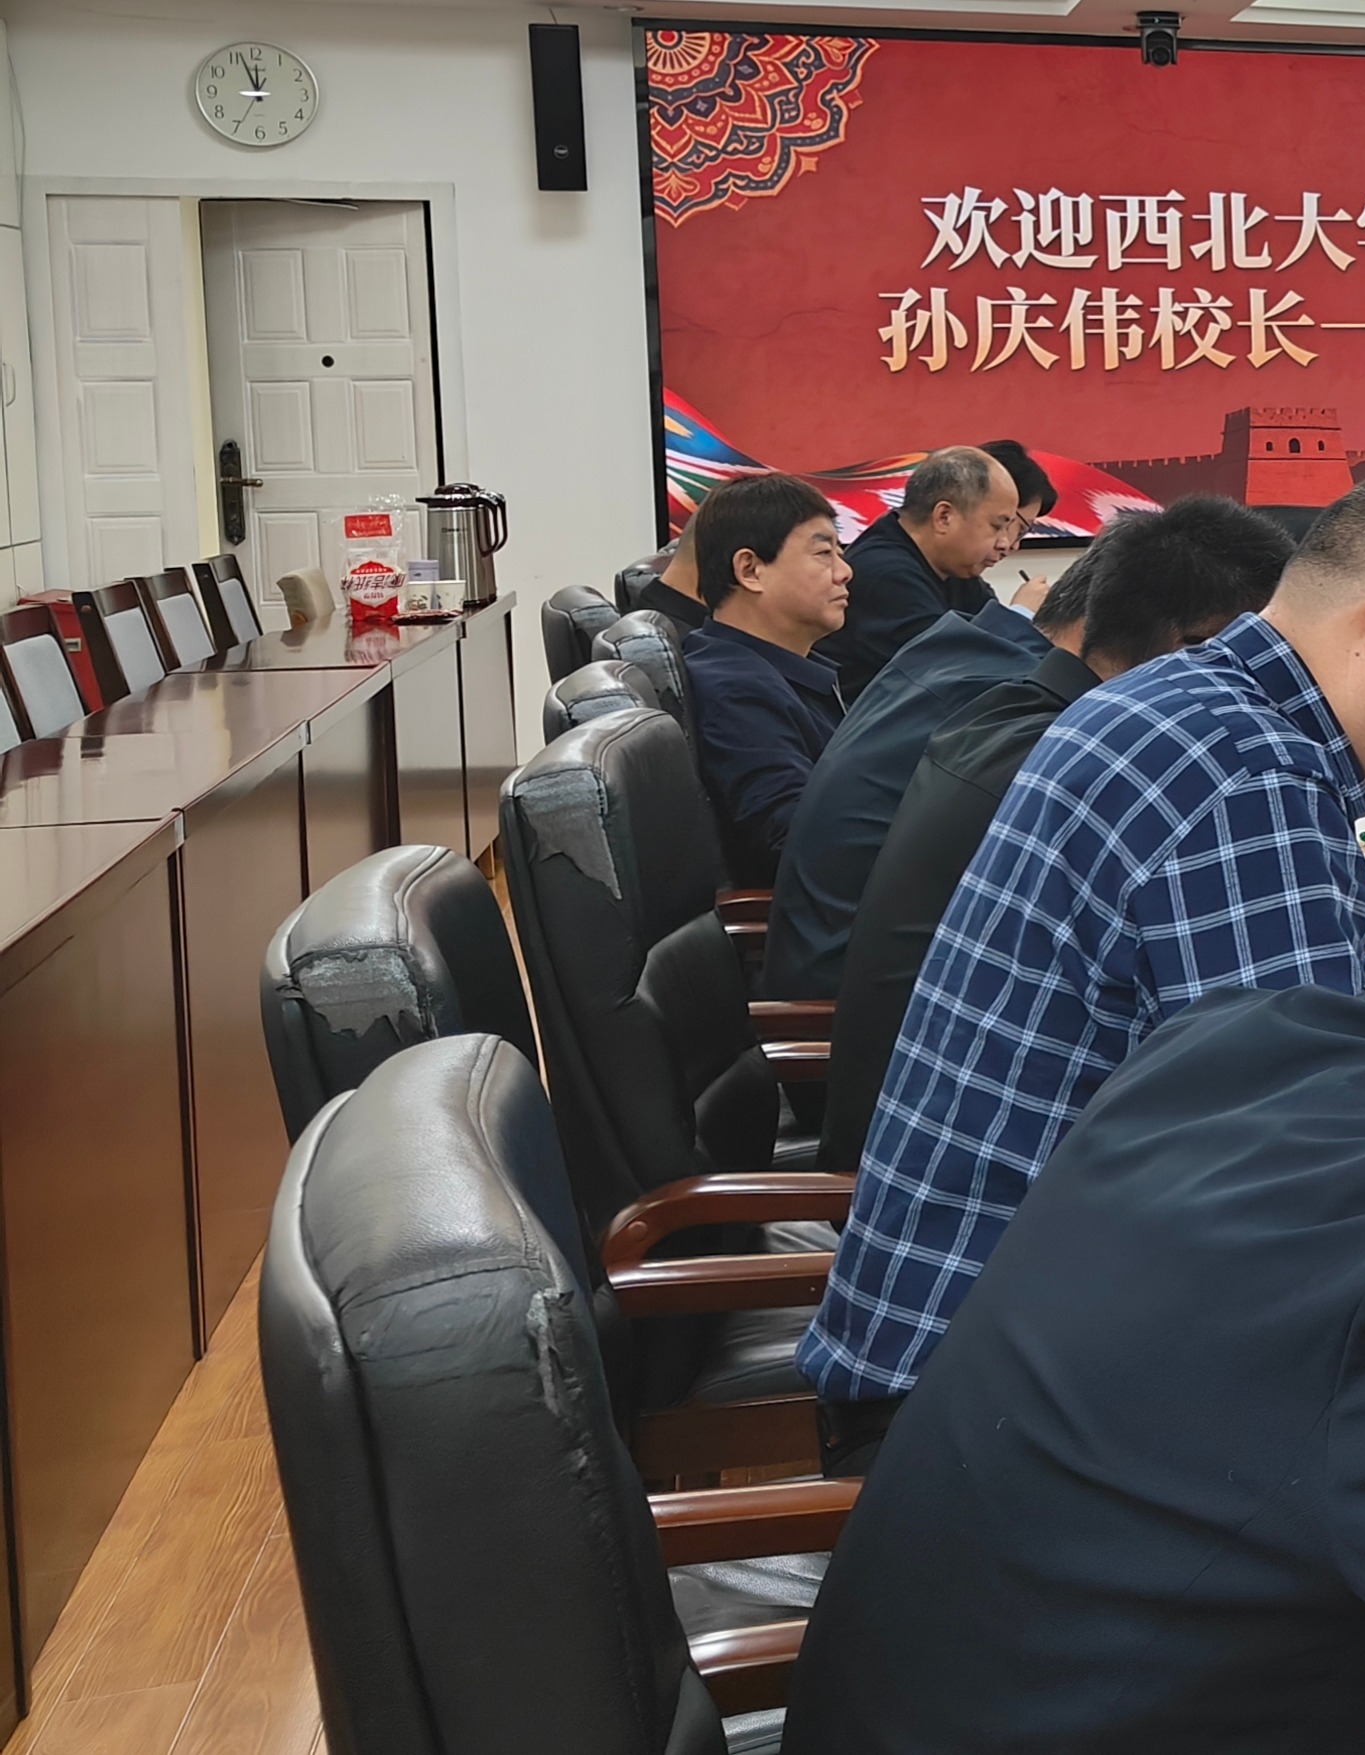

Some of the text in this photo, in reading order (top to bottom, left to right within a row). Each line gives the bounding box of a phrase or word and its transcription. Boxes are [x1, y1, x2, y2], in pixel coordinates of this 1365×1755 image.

[229, 52, 239, 65] 11
[250, 47, 262, 61] 12
[211, 65, 225, 79] 10
[293, 68, 303, 82] 2
[206, 85, 217, 99] 9
[299, 88, 309, 102] 3
[214, 105, 224, 119] 8
[294, 108, 304, 120] 4
[232, 120, 242, 134] 7
[255, 126, 266, 140] 6
[279, 121, 288, 135] 5
